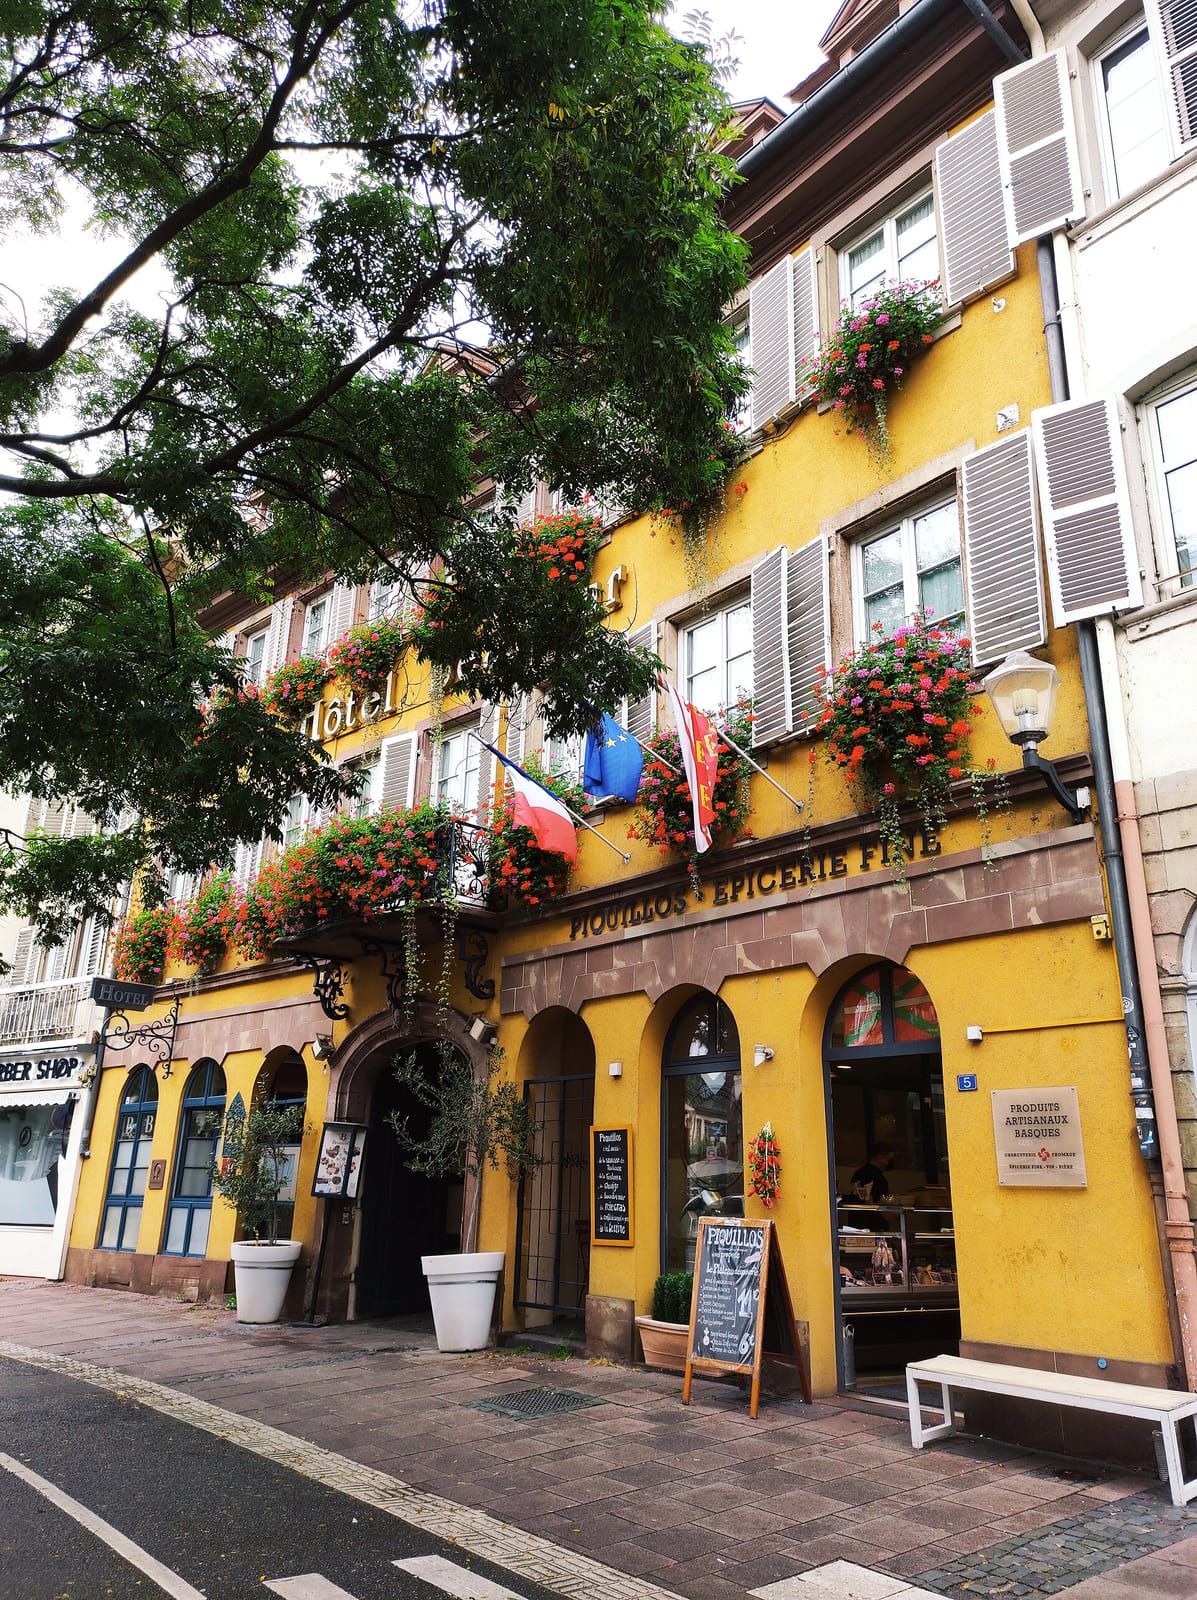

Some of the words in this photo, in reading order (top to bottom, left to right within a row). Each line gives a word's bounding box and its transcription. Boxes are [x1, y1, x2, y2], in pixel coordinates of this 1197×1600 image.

[569, 887, 687, 938] PIQUILLOS
[712, 847, 848, 906] EPICERIE
[860, 826, 942, 870] FINE
[36, 1057, 79, 1080] SHOP
[963, 1076, 972, 1088] 5
[1010, 1102, 1060, 1113] PRODUITS
[1005, 1115, 1069, 1126] ARTISANAUX
[1014, 1128, 1061, 1138] BASQUES
[707, 1226, 763, 1248] PIQUILLOS
